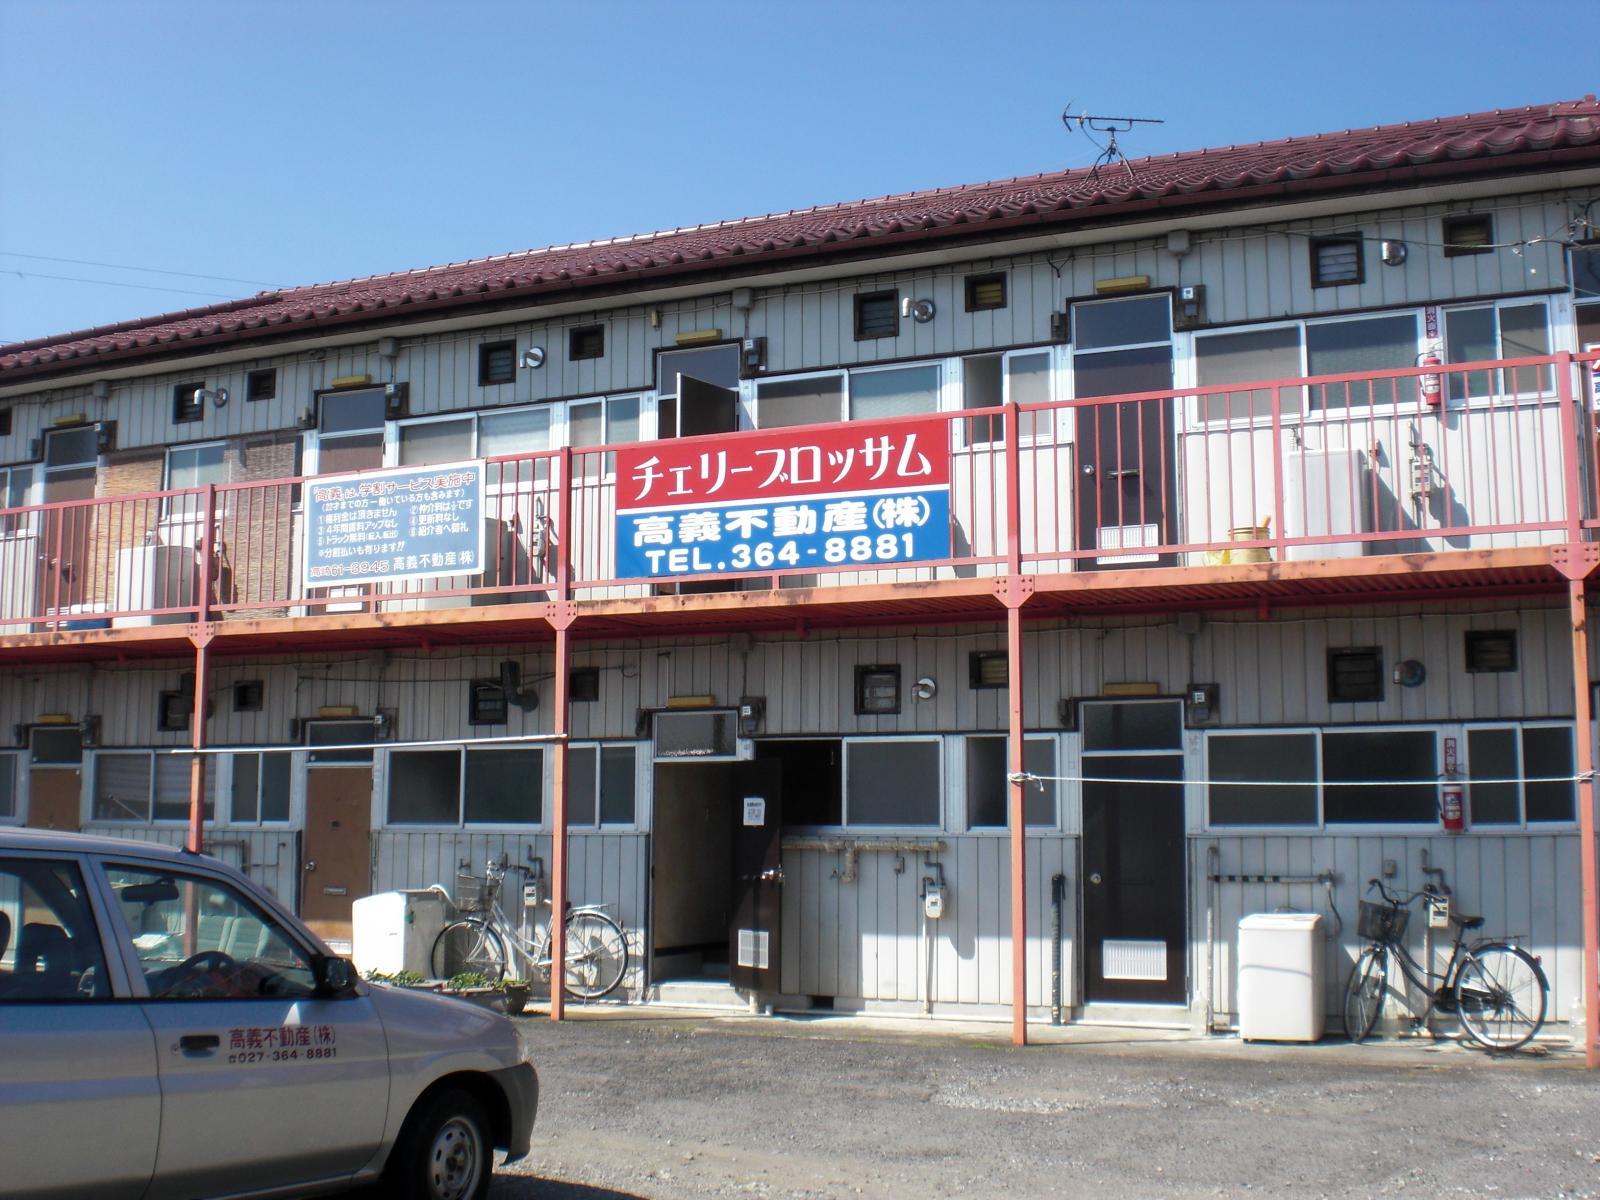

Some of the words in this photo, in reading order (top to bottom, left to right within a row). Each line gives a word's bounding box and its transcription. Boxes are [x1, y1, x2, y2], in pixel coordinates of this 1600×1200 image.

[632, 433, 932, 501] チェリーブロッサム
[633, 495, 930, 547] 高義不動産(株)
[229, 1024, 336, 1049] 高義不動産(株)
